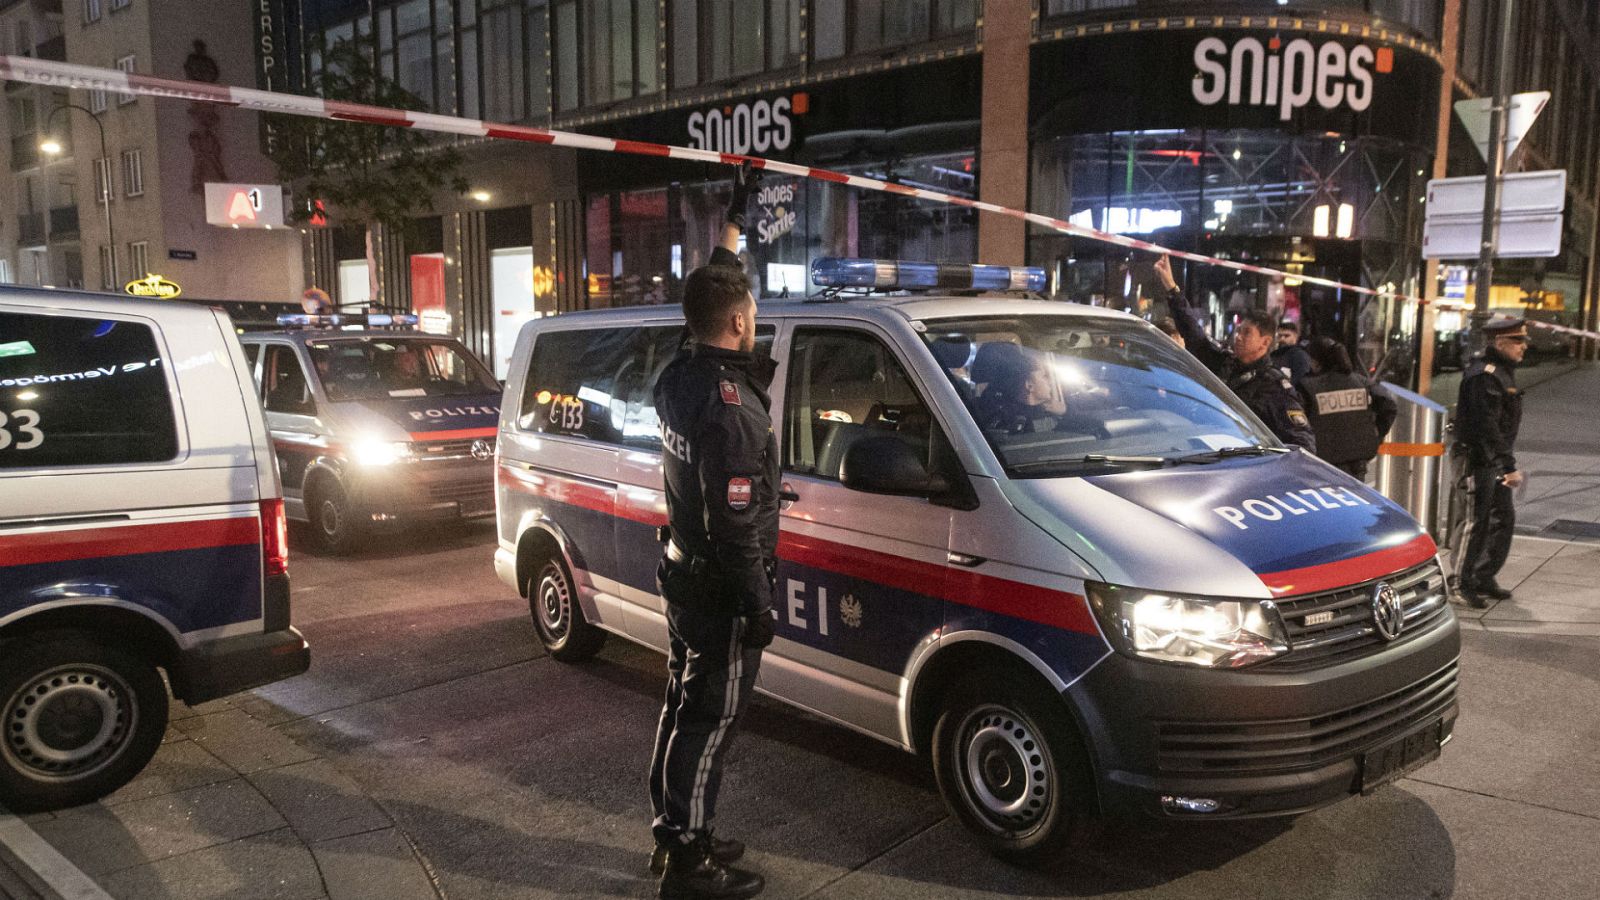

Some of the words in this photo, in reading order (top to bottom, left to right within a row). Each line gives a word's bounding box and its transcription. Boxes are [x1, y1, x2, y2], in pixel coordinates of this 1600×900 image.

[1192, 37, 1375, 120] snipes
[228, 188, 262, 221] A1
[757, 184, 793, 206] snipes
[757, 211, 796, 244] Sprite
[408, 406, 501, 421] POLIZEI
[560, 398, 584, 429] 133
[1317, 390, 1368, 412] POLIZEI
[1212, 486, 1371, 530] POLIZEI
